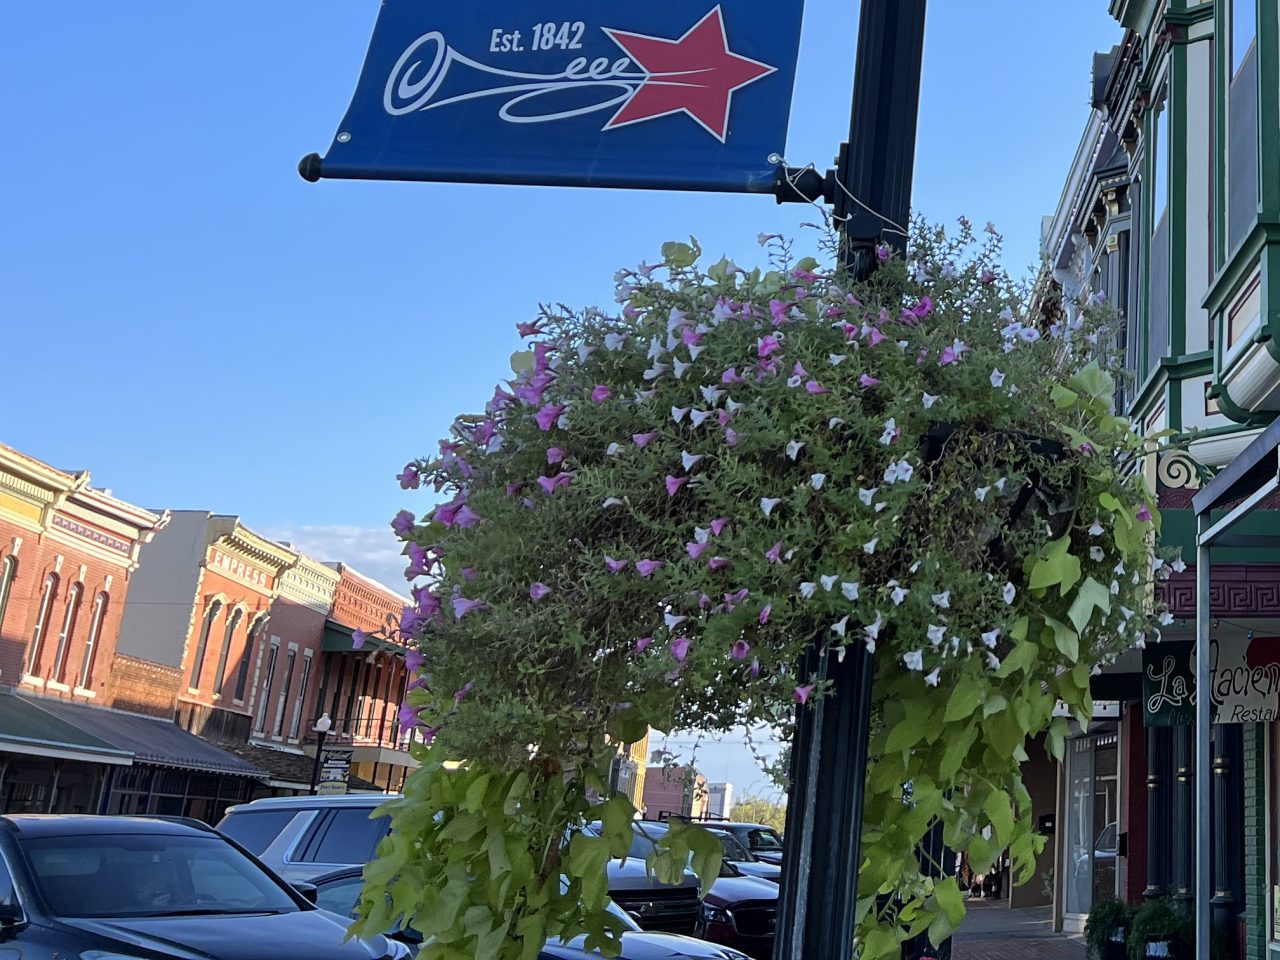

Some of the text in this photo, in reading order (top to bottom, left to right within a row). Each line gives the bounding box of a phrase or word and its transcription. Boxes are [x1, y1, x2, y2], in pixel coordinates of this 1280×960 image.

[488, 21, 586, 53] Est. 1842
[213, 550, 267, 589] EMPRESS
[1146, 655, 1189, 713] La
